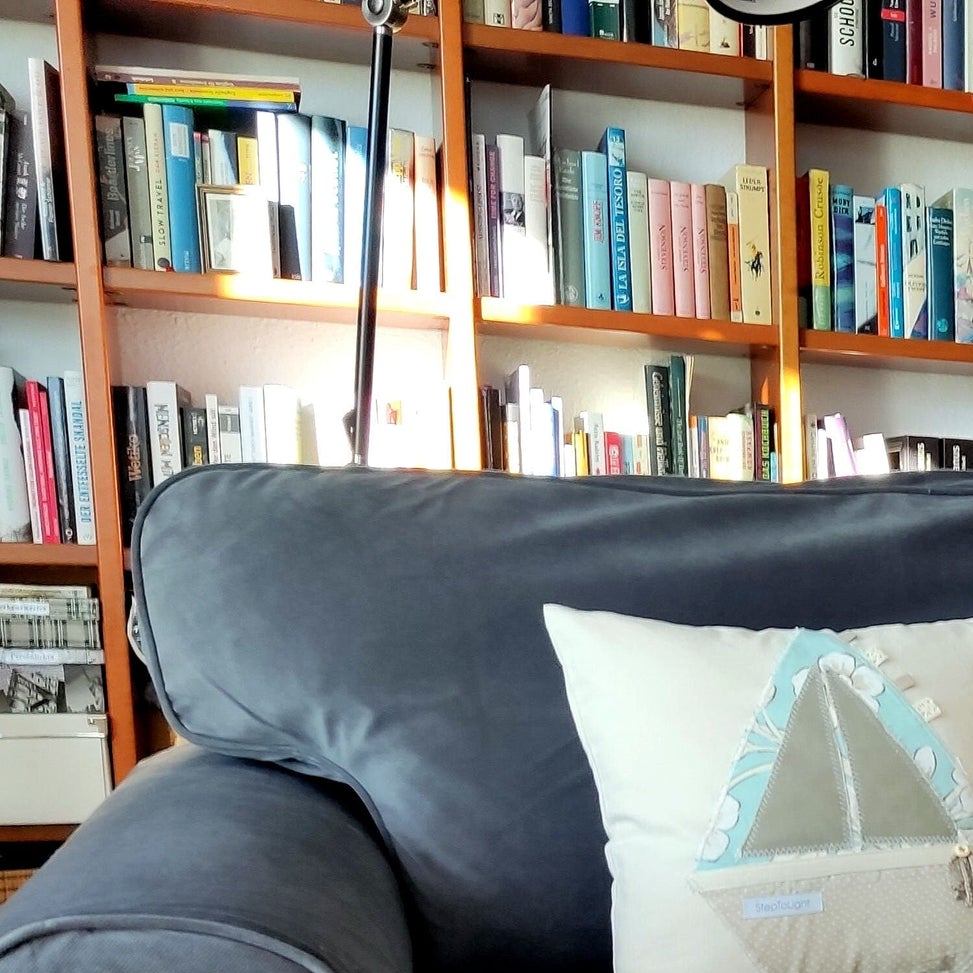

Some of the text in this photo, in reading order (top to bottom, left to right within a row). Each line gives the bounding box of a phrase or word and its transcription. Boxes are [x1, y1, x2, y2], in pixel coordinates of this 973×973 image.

[154, 179, 165, 216] TRAVEL
[832, 197, 850, 207] MOBY
[833, 206, 849, 216] DICK
[156, 219, 166, 246] SLOW
[613, 167, 628, 290] LA ISLA DEL TESORO
[813, 177, 826, 280] Robinson Crusoe
[71, 400, 92, 523] DER ENTFESSELTE SKANDAL
[127, 433, 142, 482] Wetiko
